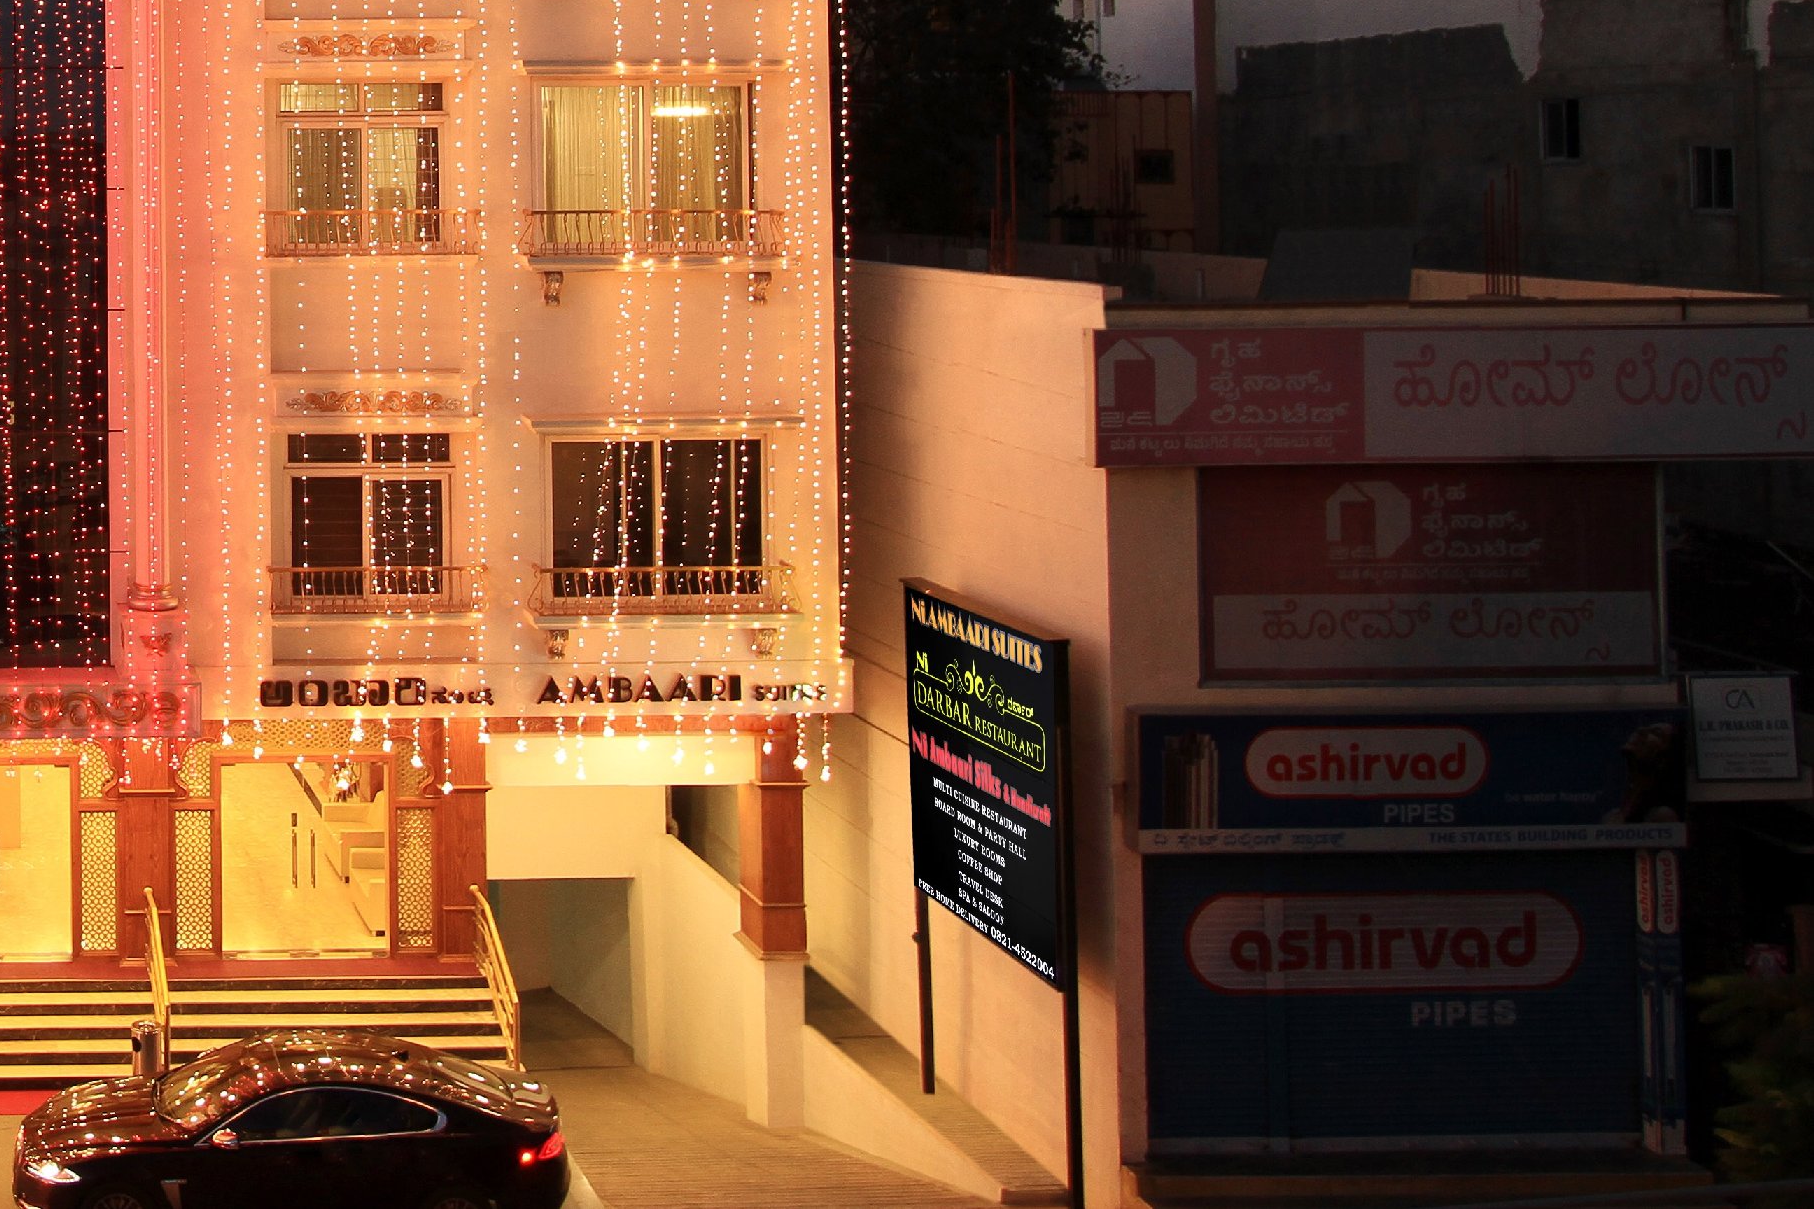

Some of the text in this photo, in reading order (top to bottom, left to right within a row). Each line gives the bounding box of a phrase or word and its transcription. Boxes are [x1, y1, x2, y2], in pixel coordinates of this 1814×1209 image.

[1210, 338, 1261, 368] ಗೃಹ
[1393, 341, 1806, 441] ಹೋಮ್ ಲೋನ್ಸ್
[1209, 402, 1350, 424] ಲಿಮಿಟೆಡ್
[1263, 597, 1610, 660] ಹೋಮ್ ಲೋನ್ಸ್
[992, 628, 1043, 674] SUITES
[537, 674, 741, 704] AMBAARI
[917, 681, 1042, 762] DARBAR RESTAURANT
[1267, 742, 1467, 784] ashirvad
[933, 776, 1027, 839] MULTI CUISINE RESTAURANT
[1384, 803, 1456, 824] PIPES
[934, 797, 1027, 861] BOARD ROOM & PARTY HALL
[954, 827, 1006, 868] LUXURY ROOMS
[1429, 827, 1673, 844] THE STATES BUILDING PRODUCTS
[958, 850, 1003, 886] COFFEE SHOP
[958, 888, 971, 904] SPA
[972, 897, 978, 908] &
[959, 871, 1004, 909] TRAVEL DESK
[919, 878, 1055, 980] FREE HOME DELIVERY 0821-4522004
[1230, 910, 1537, 973] ashirvad
[1411, 999, 1517, 1028] PIPES
